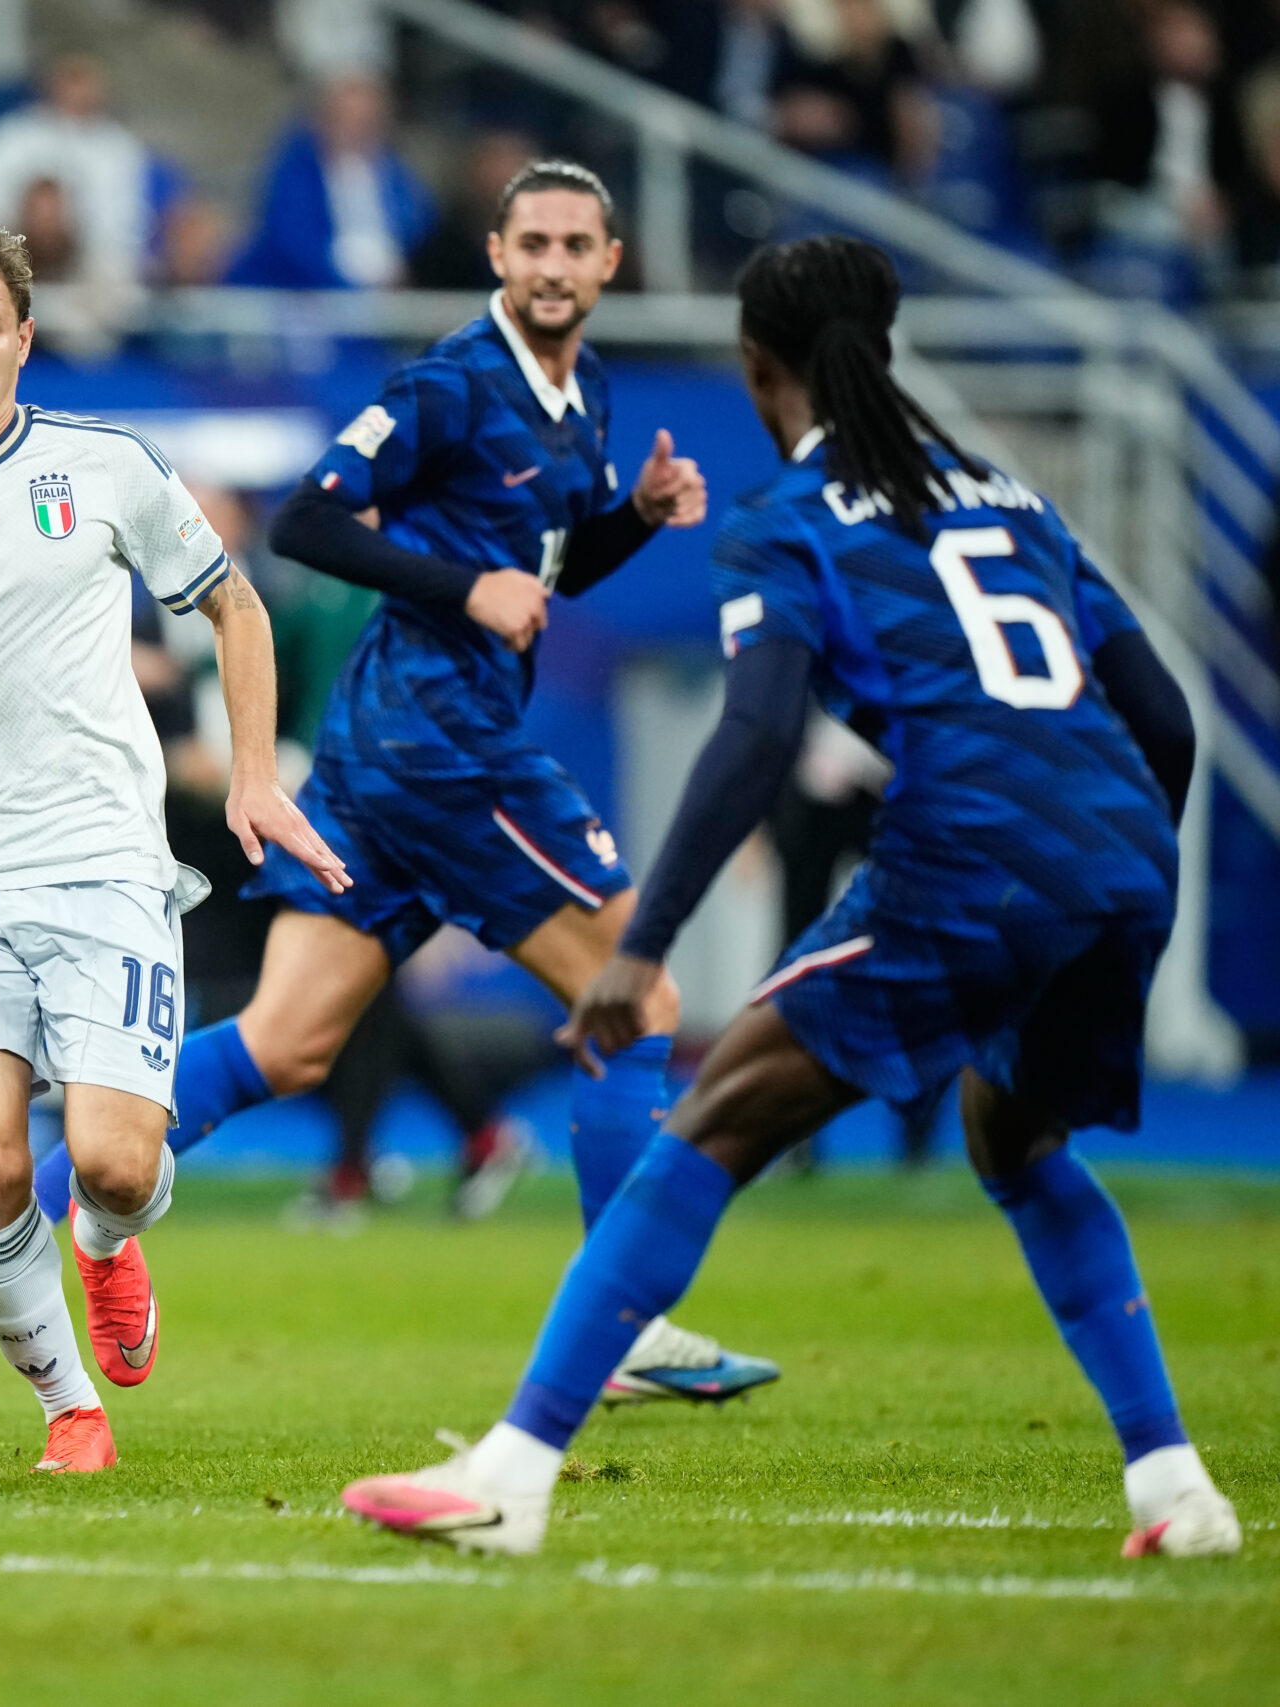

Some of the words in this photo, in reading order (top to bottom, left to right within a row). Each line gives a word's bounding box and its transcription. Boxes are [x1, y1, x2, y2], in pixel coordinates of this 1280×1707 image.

[34, 487, 68, 500] ITALIA
[928, 526, 1086, 710] 6
[122, 956, 175, 1041] 18
